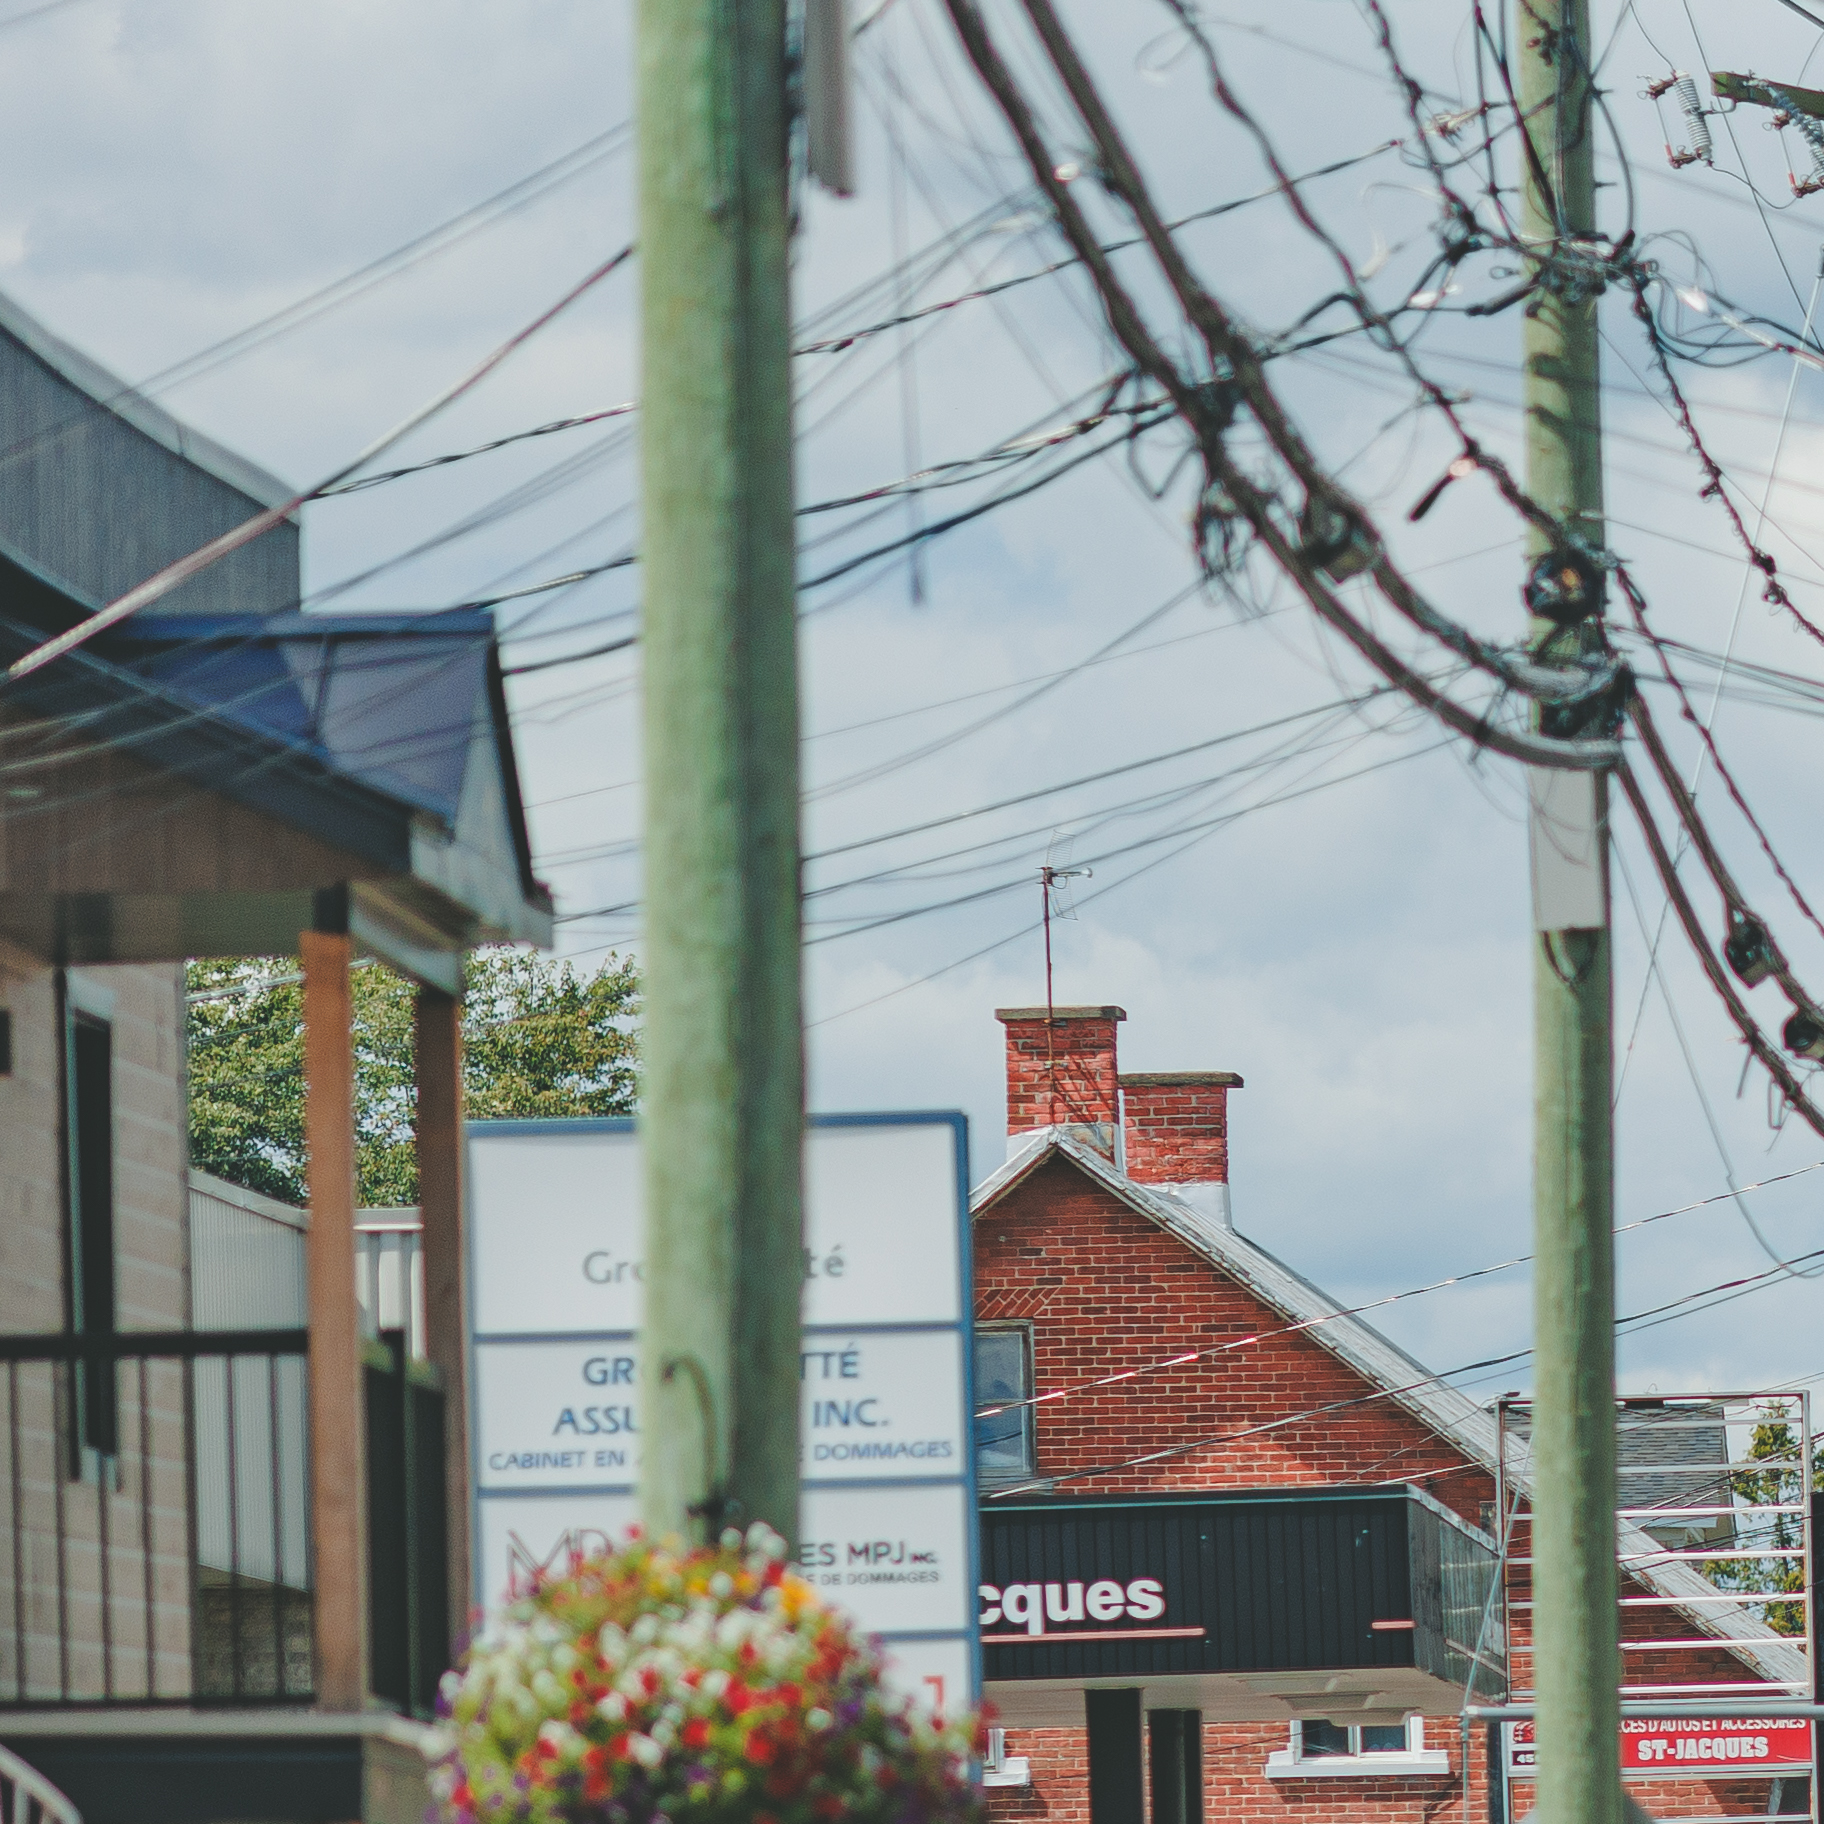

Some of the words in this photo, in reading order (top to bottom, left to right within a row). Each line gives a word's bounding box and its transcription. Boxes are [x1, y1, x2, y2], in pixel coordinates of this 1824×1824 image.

[813, 1398, 889, 1428] INC.
[488, 1450, 585, 1472] CABINET
[594, 1449, 626, 1468] EN
[813, 1441, 953, 1462] DOMMAGES
[846, 1540, 905, 1565] MPJ
[847, 1571, 939, 1585] DOMMAGES
[978, 1577, 1166, 1636] cques
[1637, 1736, 1769, 1761] ST-JACQUES
